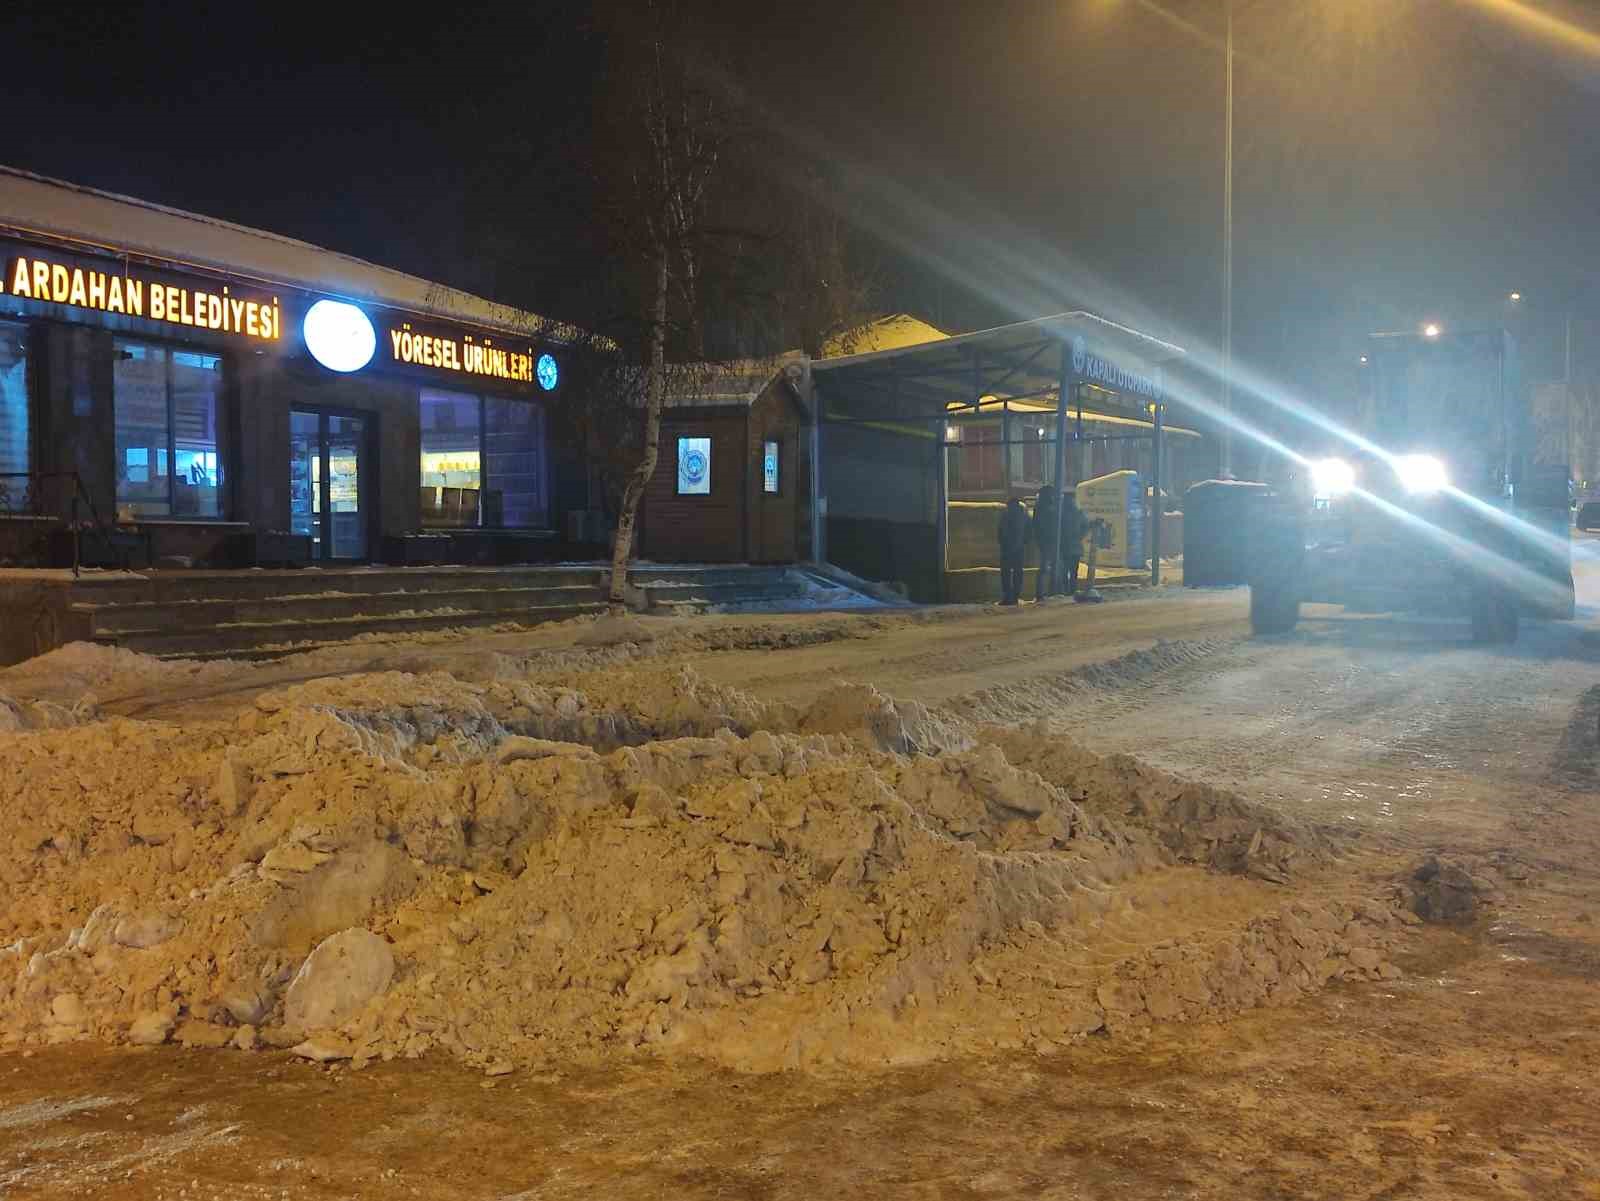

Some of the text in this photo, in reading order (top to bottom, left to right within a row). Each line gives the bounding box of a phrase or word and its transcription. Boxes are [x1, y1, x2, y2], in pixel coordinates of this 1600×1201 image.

[12, 257, 280, 340] ARDAHAN BELEDİYESİ
[390, 323, 533, 382] YÖRESEL ÜRÜNLERİ
